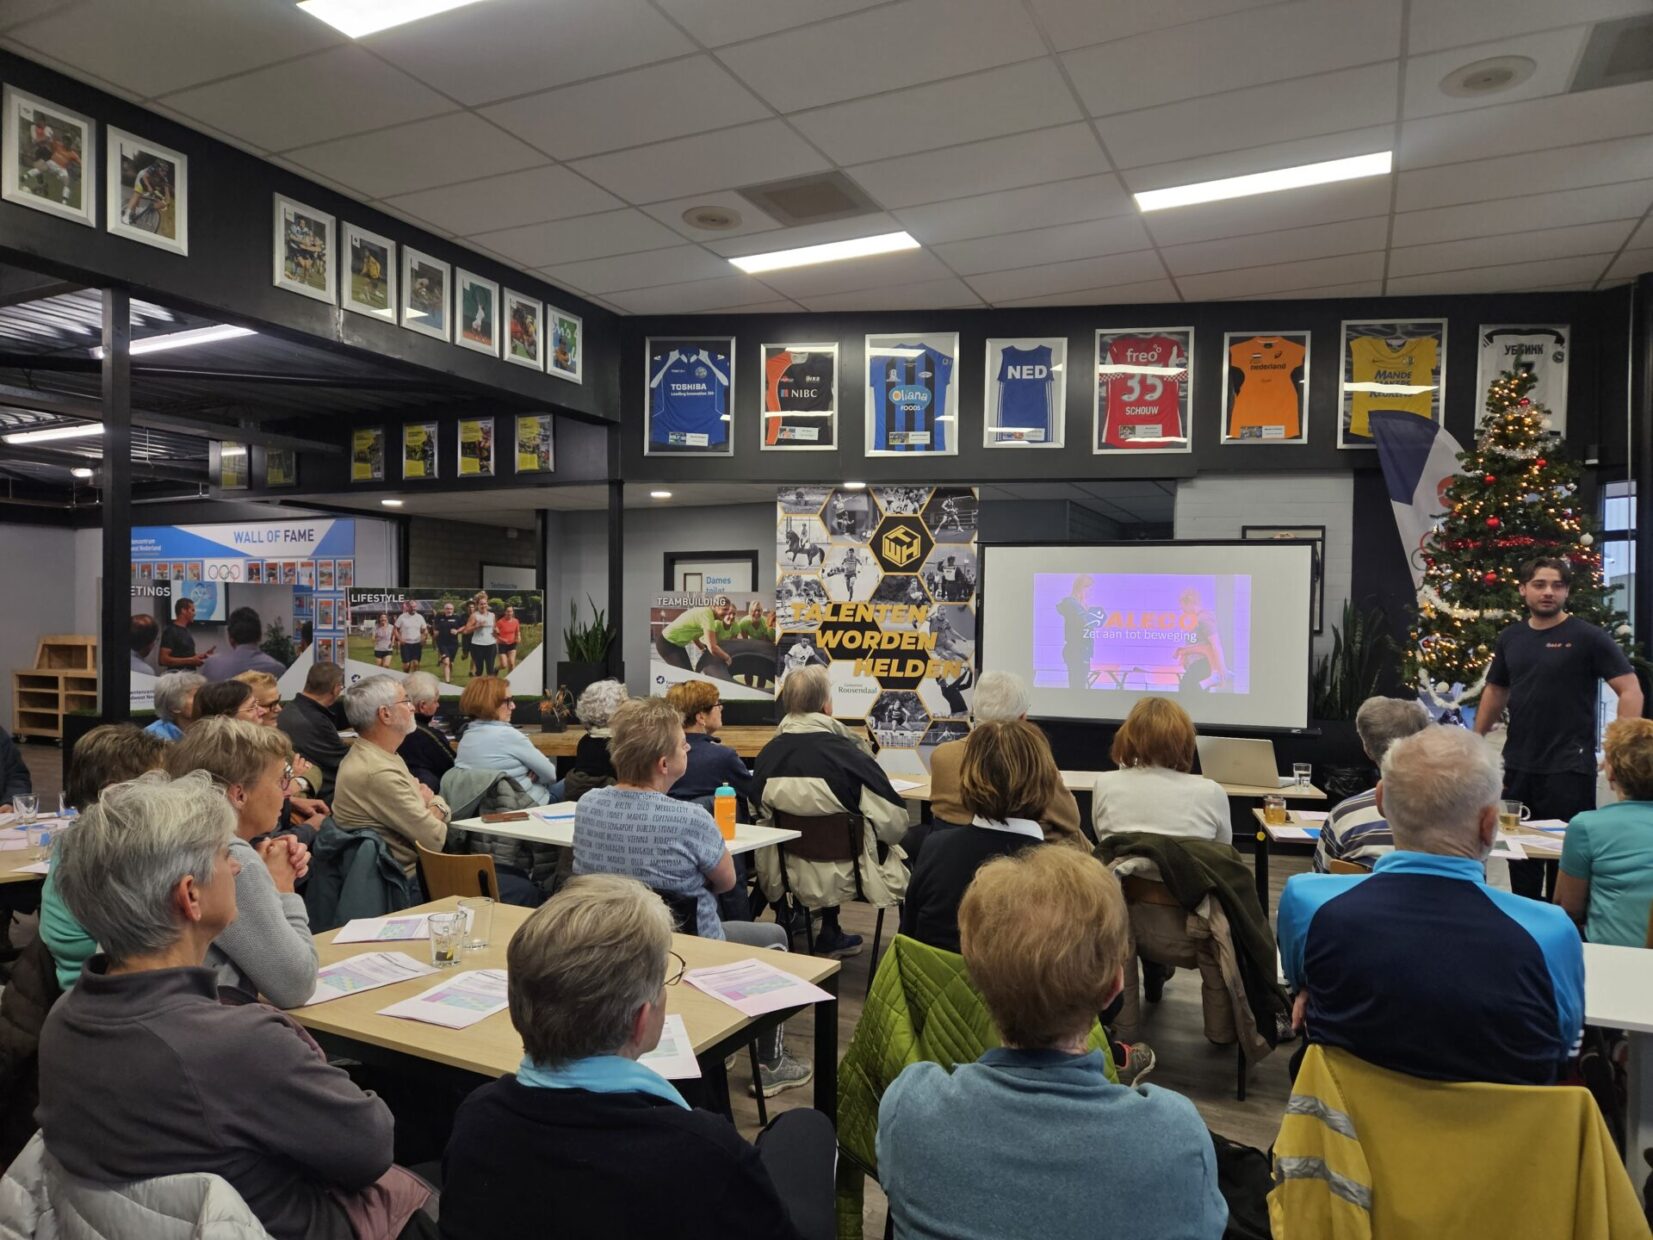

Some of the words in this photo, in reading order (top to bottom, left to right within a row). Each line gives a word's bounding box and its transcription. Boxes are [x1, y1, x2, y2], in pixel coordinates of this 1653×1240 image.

[1126, 348, 1158, 362] freo
[1007, 365, 1047, 379] NED
[671, 383, 707, 391] TOSHIBA
[791, 389, 817, 398] NIBC
[1125, 406, 1159, 415] SCHOUW
[234, 530, 264, 543] WALL
[266, 530, 280, 542] OF
[284, 528, 315, 542] FAME
[706, 576, 731, 584] Dames
[131, 585, 171, 597] ETINGS
[351, 593, 405, 603] LIFESTYLE
[657, 597, 726, 606] TEAMBUILDING
[790, 602, 928, 624] TALENTEN
[815, 630, 938, 650] WORDEN
[1082, 628, 1100, 639] Zet
[1103, 630, 1122, 639] aan
[1126, 629, 1141, 640] tot
[1144, 629, 1198, 643] beweging
[853, 658, 963, 678] HELDEN
